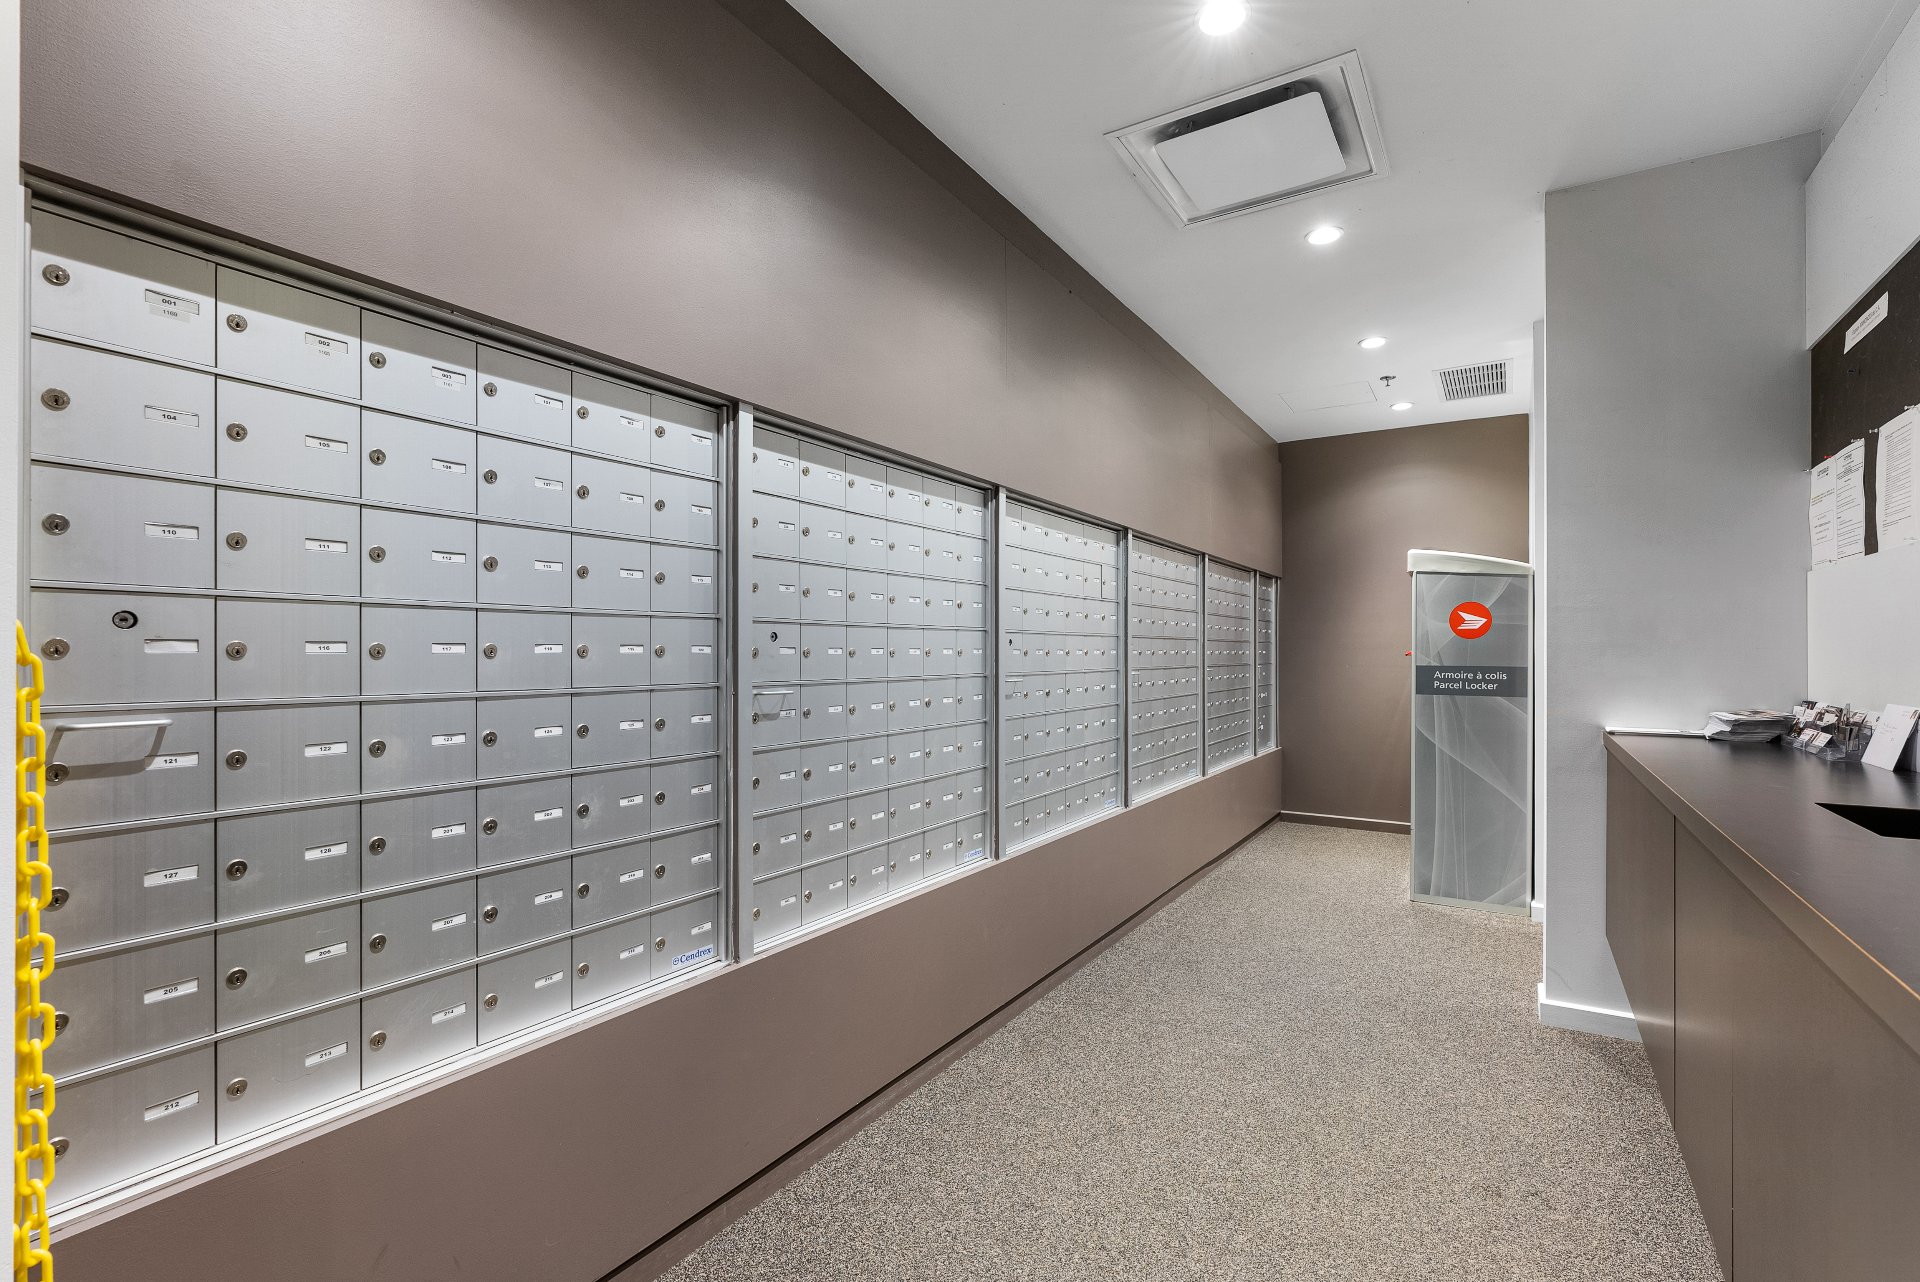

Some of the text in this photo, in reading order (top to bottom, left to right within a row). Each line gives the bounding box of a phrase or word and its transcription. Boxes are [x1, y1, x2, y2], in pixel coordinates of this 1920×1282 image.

[1434, 671, 1507, 680] Armoire à colis
[1434, 681, 1498, 690] Parcel Locker
[680, 948, 712, 963] Cendrex
[164, 1102, 179, 1110] 212
